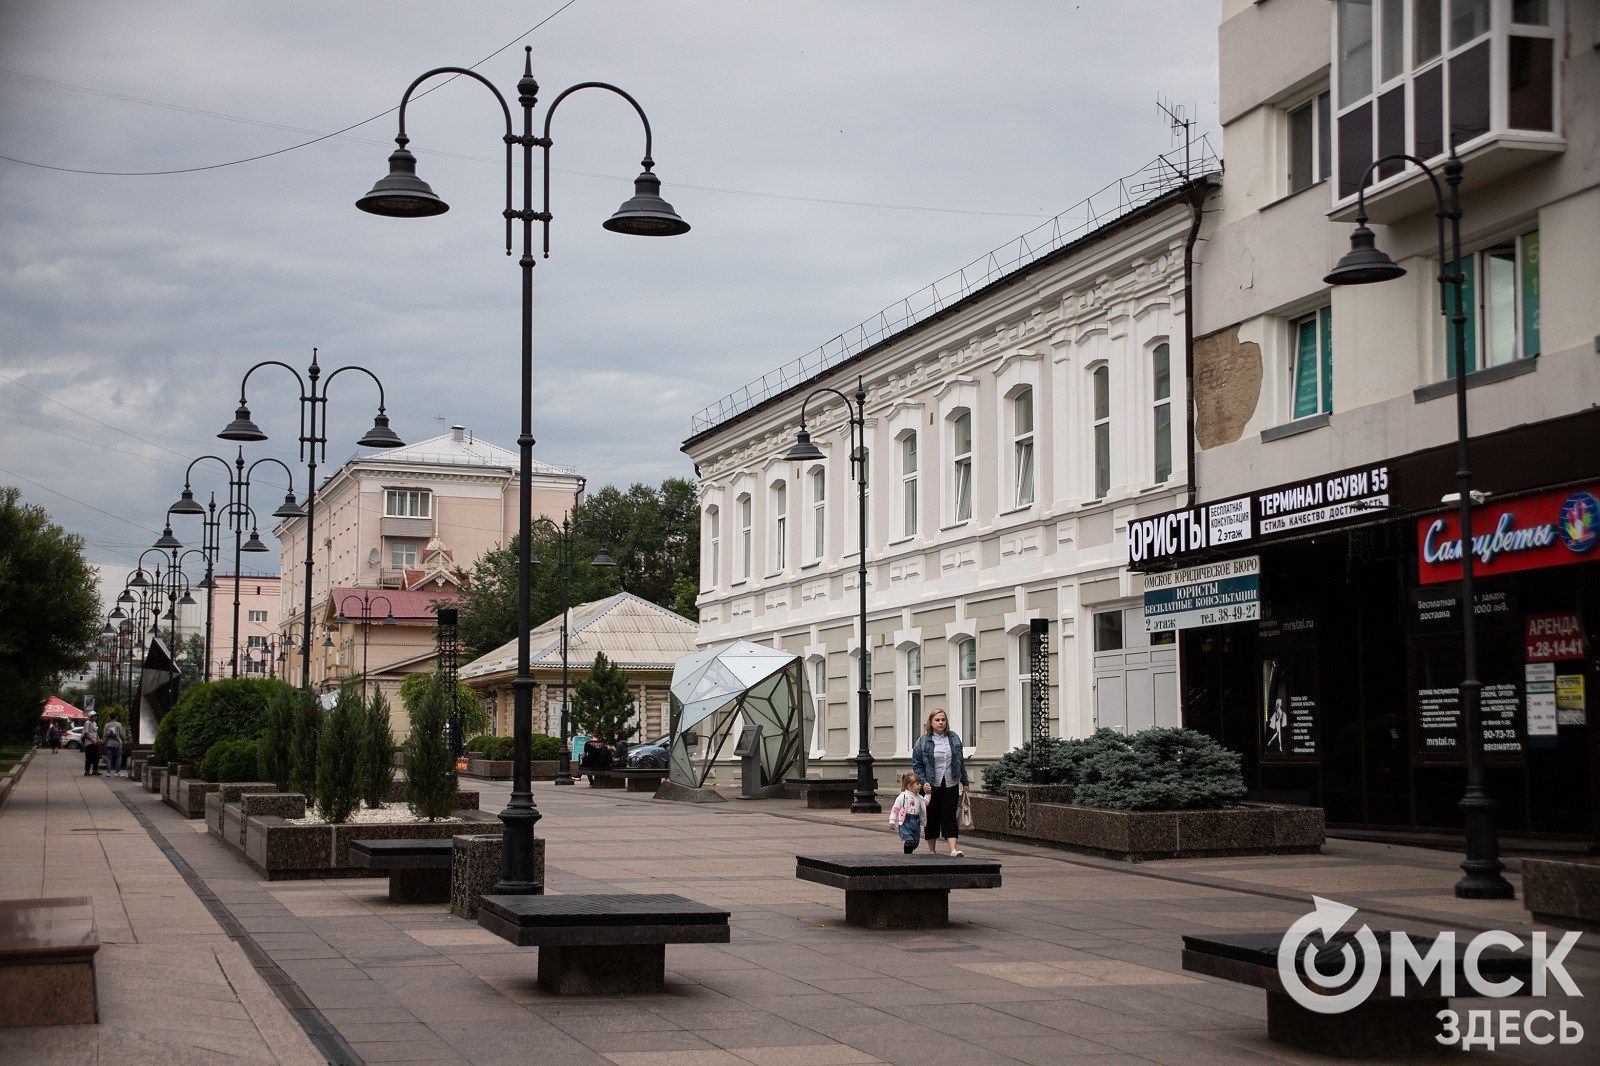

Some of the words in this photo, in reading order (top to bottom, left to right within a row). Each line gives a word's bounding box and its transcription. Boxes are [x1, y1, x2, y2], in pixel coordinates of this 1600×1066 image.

[1259, 483, 1323, 517] ТЕРМИНАЛ
[1326, 471, 1368, 502] ОБУВИ
[1371, 467, 1389, 493] 55
[1210, 501, 1243, 517] БЕСПЛАТНАЯ
[1210, 511, 1249, 528] КОНСУЛЬТАЦИЯ
[1264, 519, 1286, 532] СТИЛЬ
[1289, 510, 1326, 527] КАЧЕСТВО
[1127, 507, 1206, 563] ЮРИСТЫ
[1217, 529, 1223, 542] 2
[1223, 527, 1243, 541] этаж
[1144, 573, 1172, 589] ОМСКОЕ
[1174, 563, 1231, 584] ЮРИДИЧЕСКОЕ
[1233, 558, 1257, 573] БЮРО
[1176, 582, 1219, 600] ЮРИСТЫ
[1145, 599, 1193, 615] БЕСПЛАТНЫЕ
[1195, 589, 1257, 608] КОНСУЛЬТАЦИИ
[1417, 598, 1456, 610] бесплатная
[1145, 618, 1151, 631] 2
[1153, 618, 1176, 630] этаж
[1200, 613, 1217, 625] тел.
[1218, 604, 1257, 622] 38-49-27
[1282, 617, 1315, 631] mrstal.ru
[1420, 609, 1451, 621] доставка
[1528, 616, 1580, 636] АРЕНДА
[1527, 638, 1584, 657] т.28-14-41
[1426, 736, 1457, 746] mrstal.ru
[1483, 729, 1516, 739] 90-73-73
